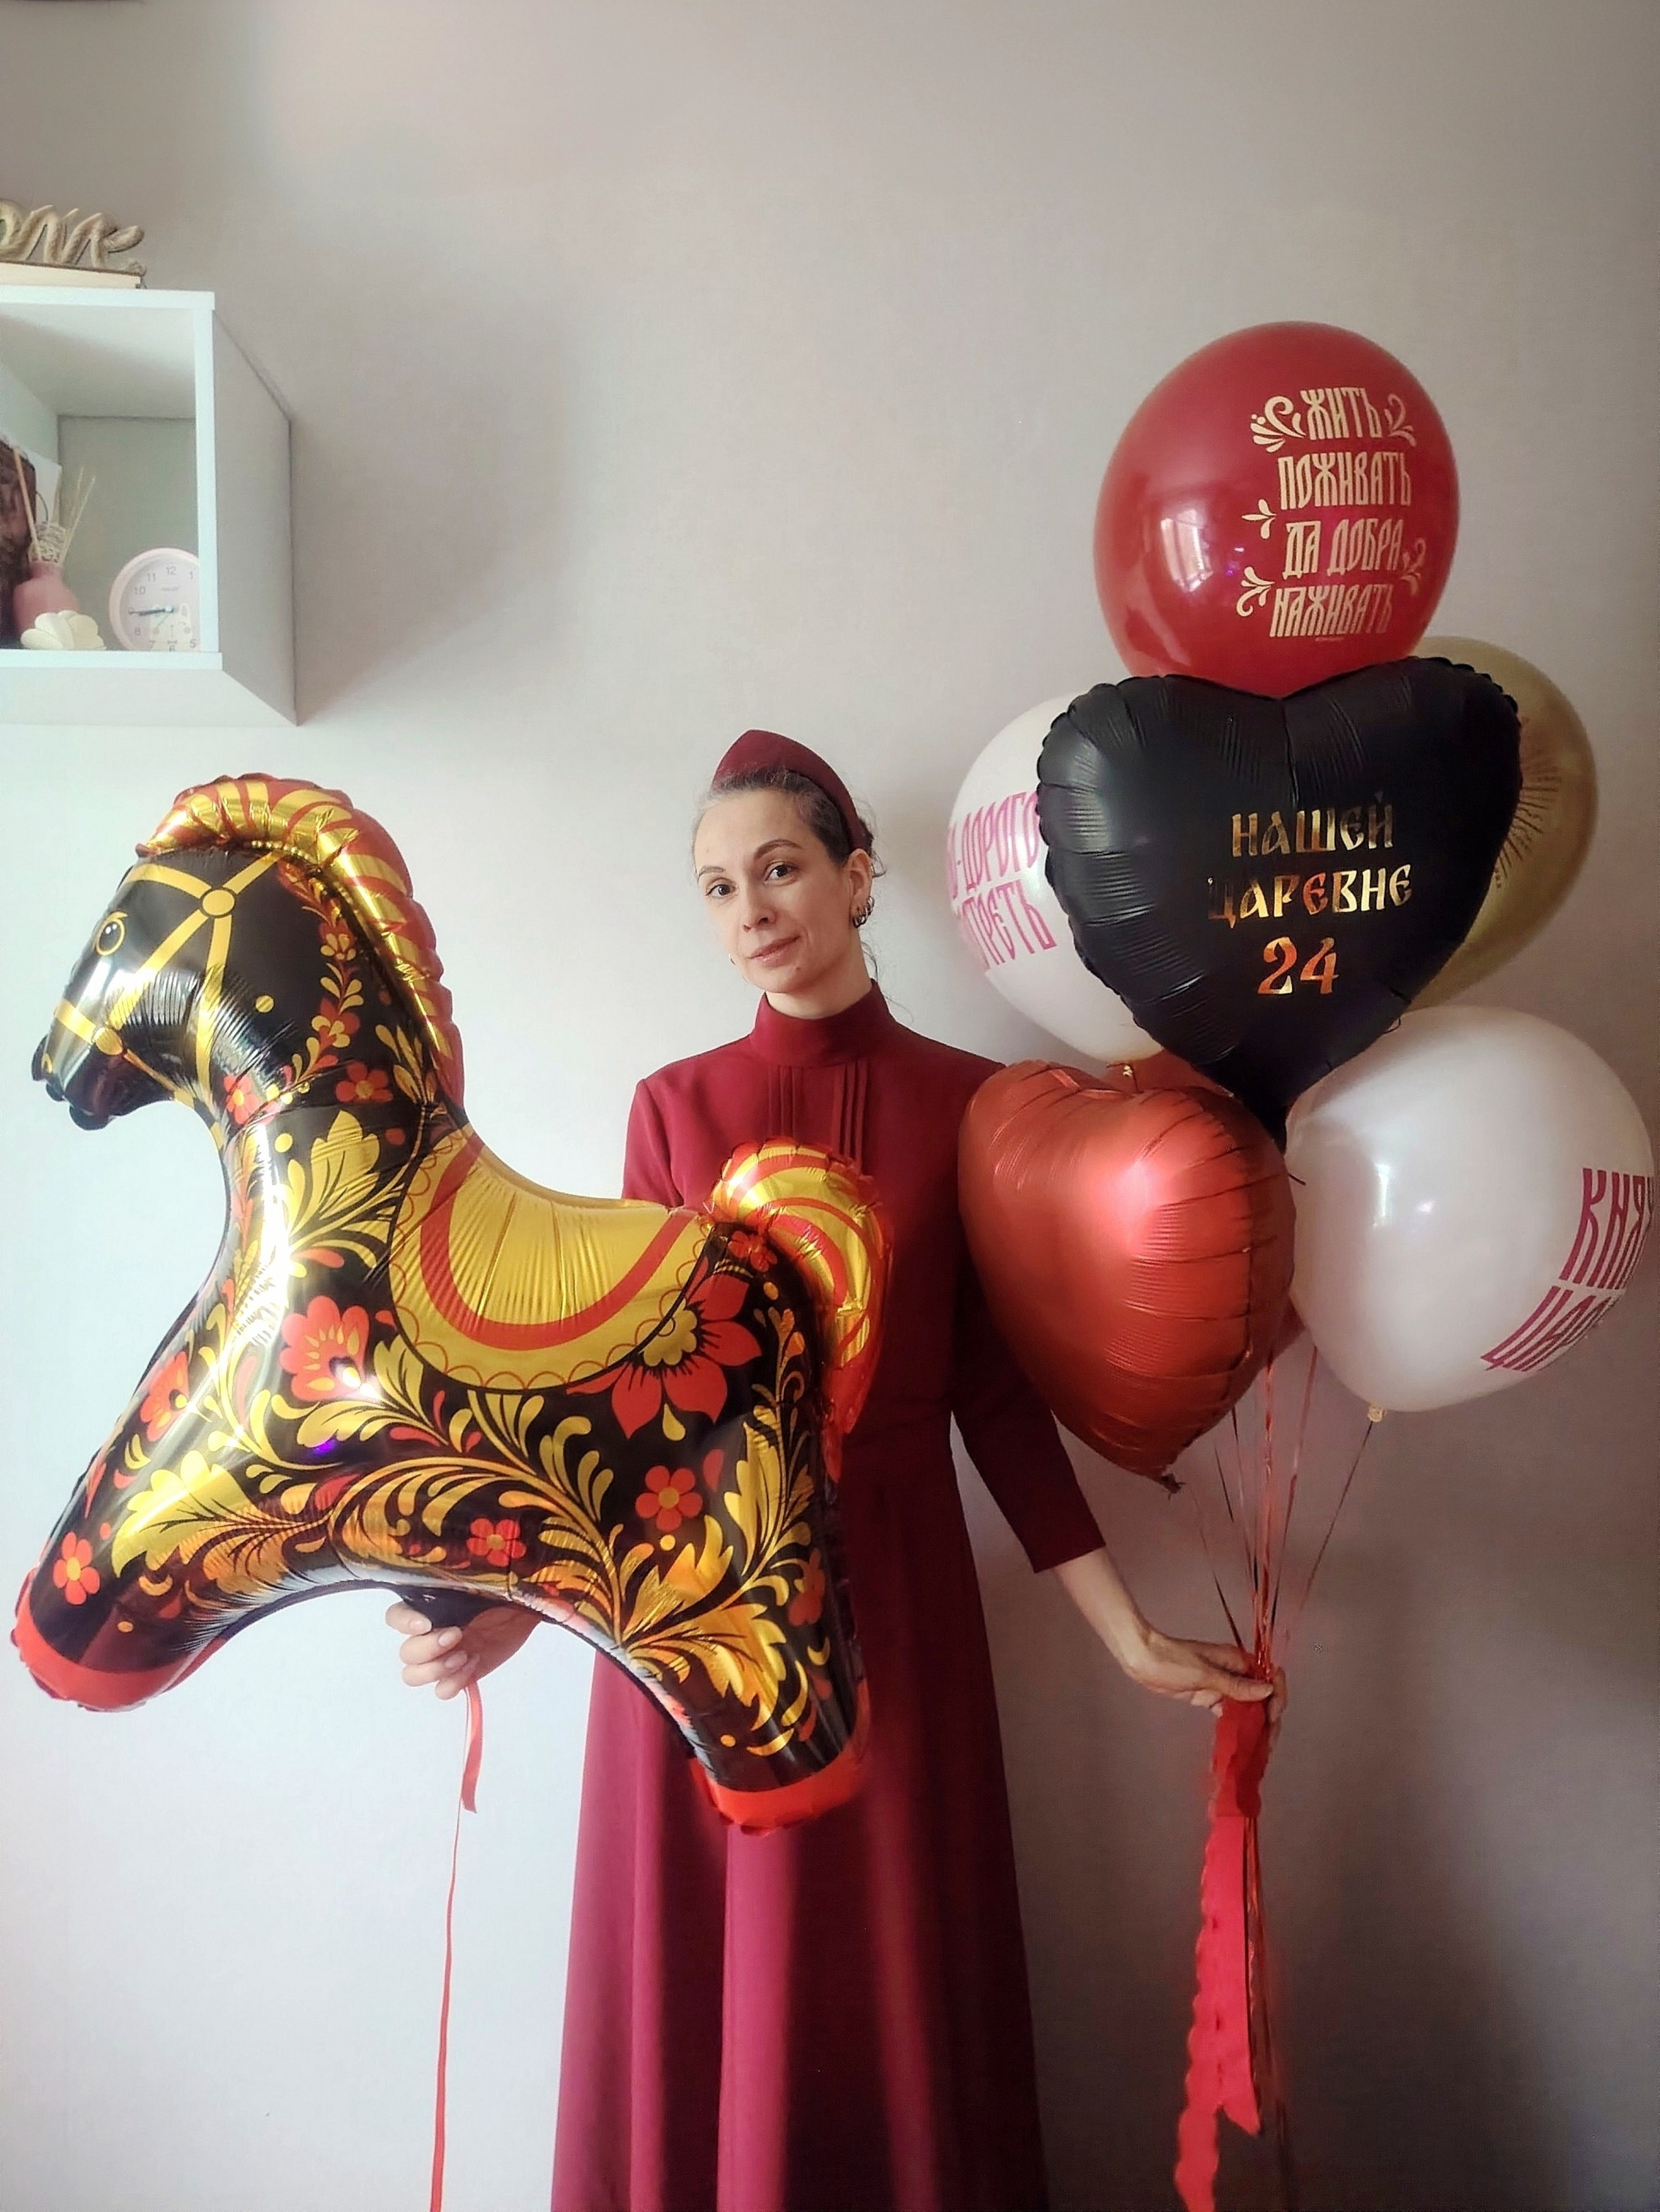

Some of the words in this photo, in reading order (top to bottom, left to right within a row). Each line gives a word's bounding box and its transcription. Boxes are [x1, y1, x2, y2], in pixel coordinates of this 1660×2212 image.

[1300, 387, 1382, 440] ЖИТЬ
[1278, 452, 1412, 510] ПОЖИВАТЬ
[147, 572, 156, 582] 11
[166, 565, 177, 576] 12
[1283, 521, 1322, 580] ДА
[1327, 519, 1404, 576] ДОБРА
[134, 585, 146, 595] 10
[1270, 583, 1394, 638] НАЖИВАТЬ
[1258, 937, 1340, 994] 24
[1558, 1168, 1653, 1289] КНЯ
